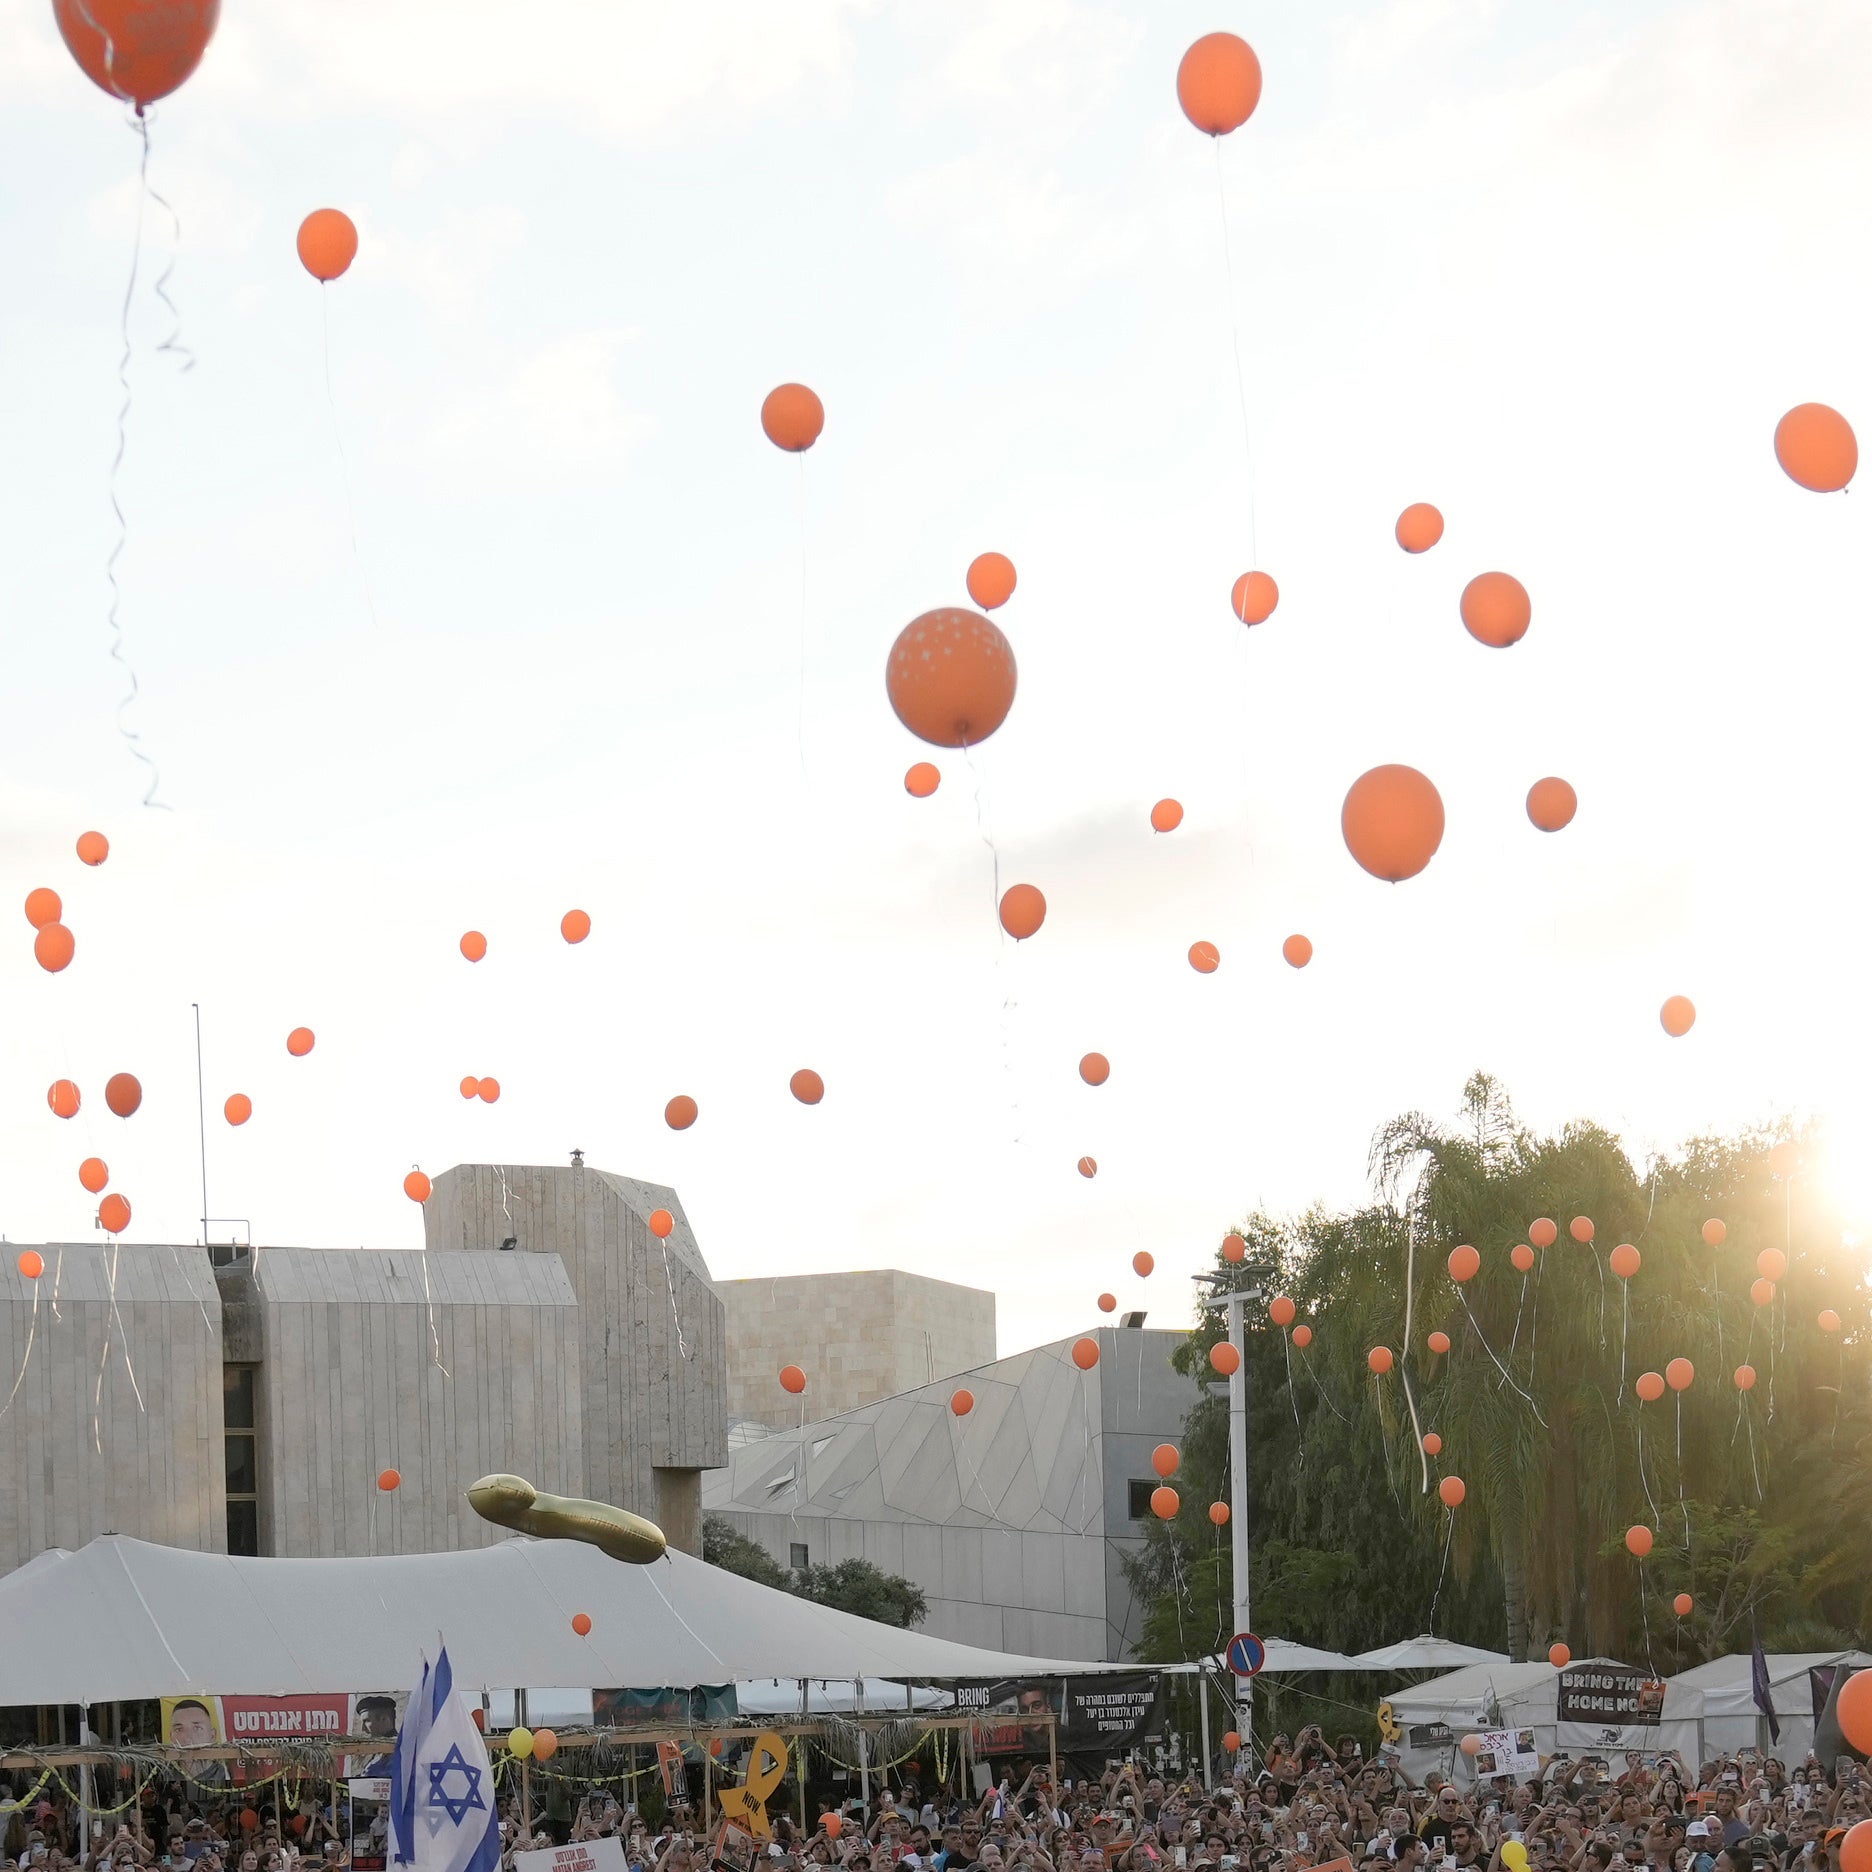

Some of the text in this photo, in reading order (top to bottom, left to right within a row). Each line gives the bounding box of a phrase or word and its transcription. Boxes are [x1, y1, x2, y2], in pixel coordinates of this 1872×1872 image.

[1561, 1673, 1614, 1691] BRING
[957, 1687, 990, 1707] BRING
[1567, 1694, 1615, 1712] HOME
[233, 1709, 340, 1732] מתן אנגרסט
[742, 1790, 762, 1817] NOW.
